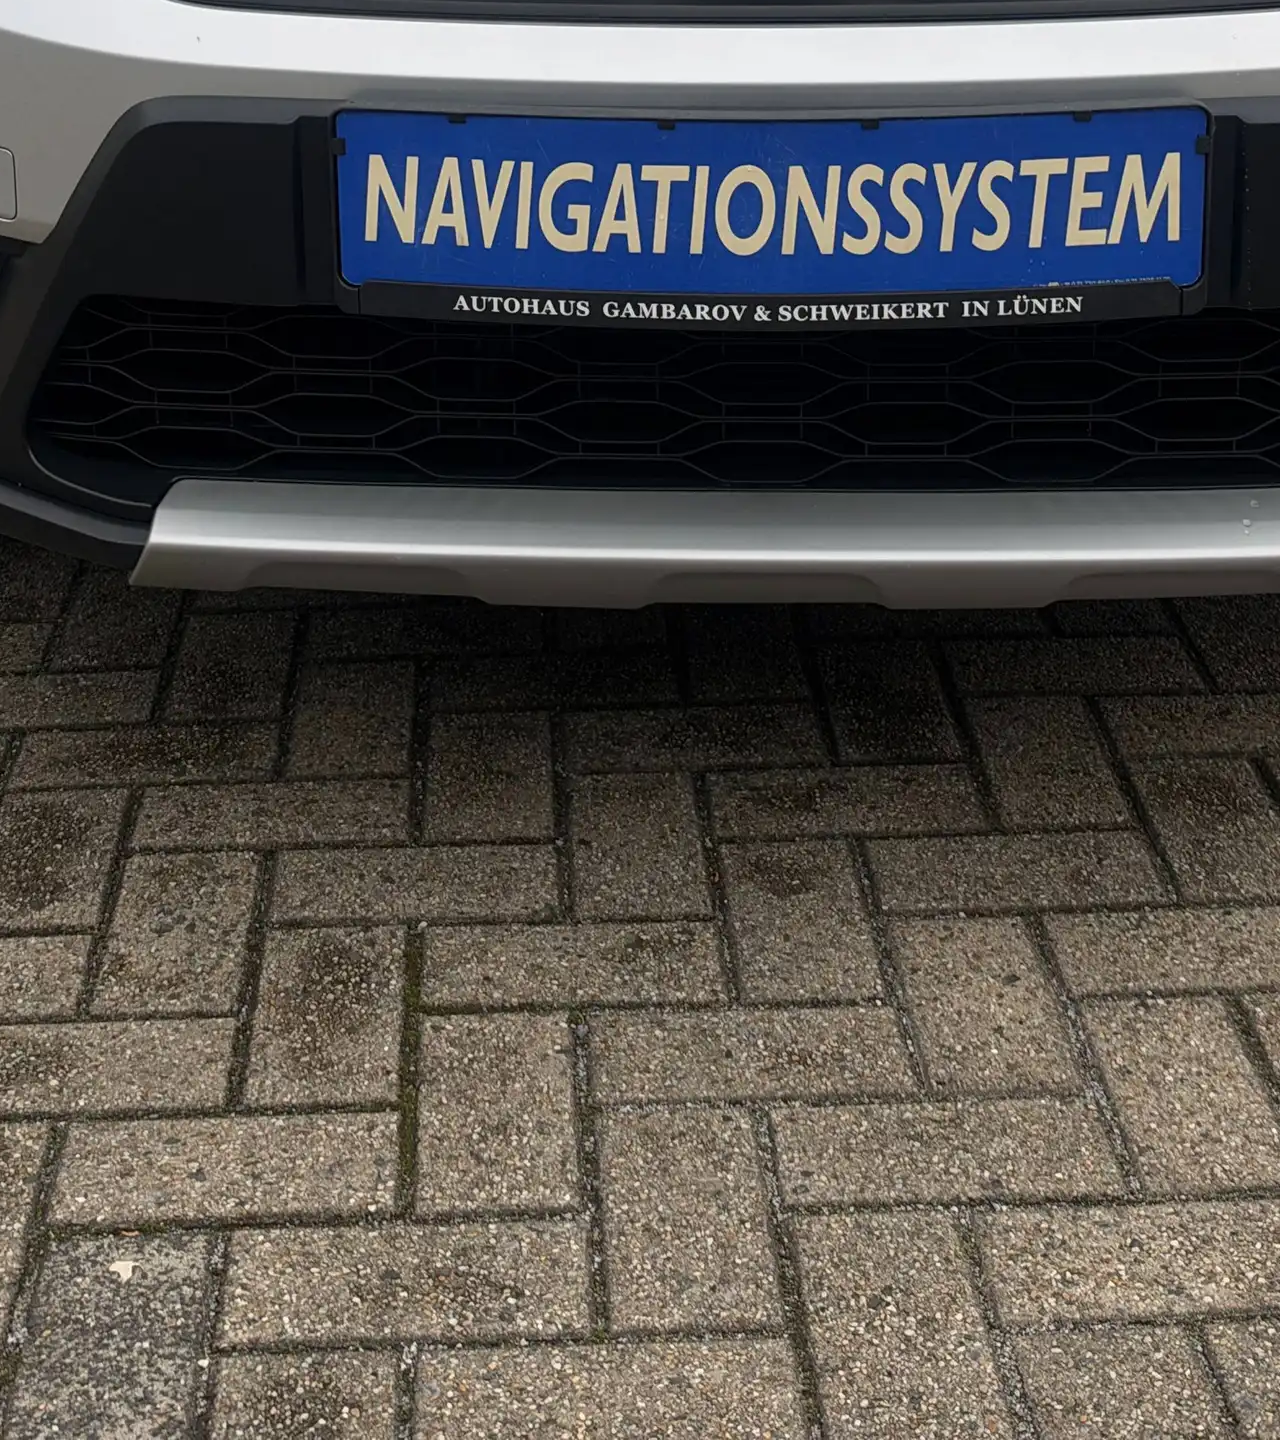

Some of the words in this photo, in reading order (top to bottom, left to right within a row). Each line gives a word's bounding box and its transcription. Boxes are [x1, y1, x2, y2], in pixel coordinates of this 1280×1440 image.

[364, 152, 1182, 256] NAVIGATIONSSYSTEM
[453, 294, 590, 317] AUTOHAUS
[602, 301, 748, 322] GAMBAROV
[753, 304, 772, 322] &
[777, 302, 949, 322] SCHWEIKERT
[961, 300, 990, 317] IN
[997, 294, 1083, 317] LÜNEN
